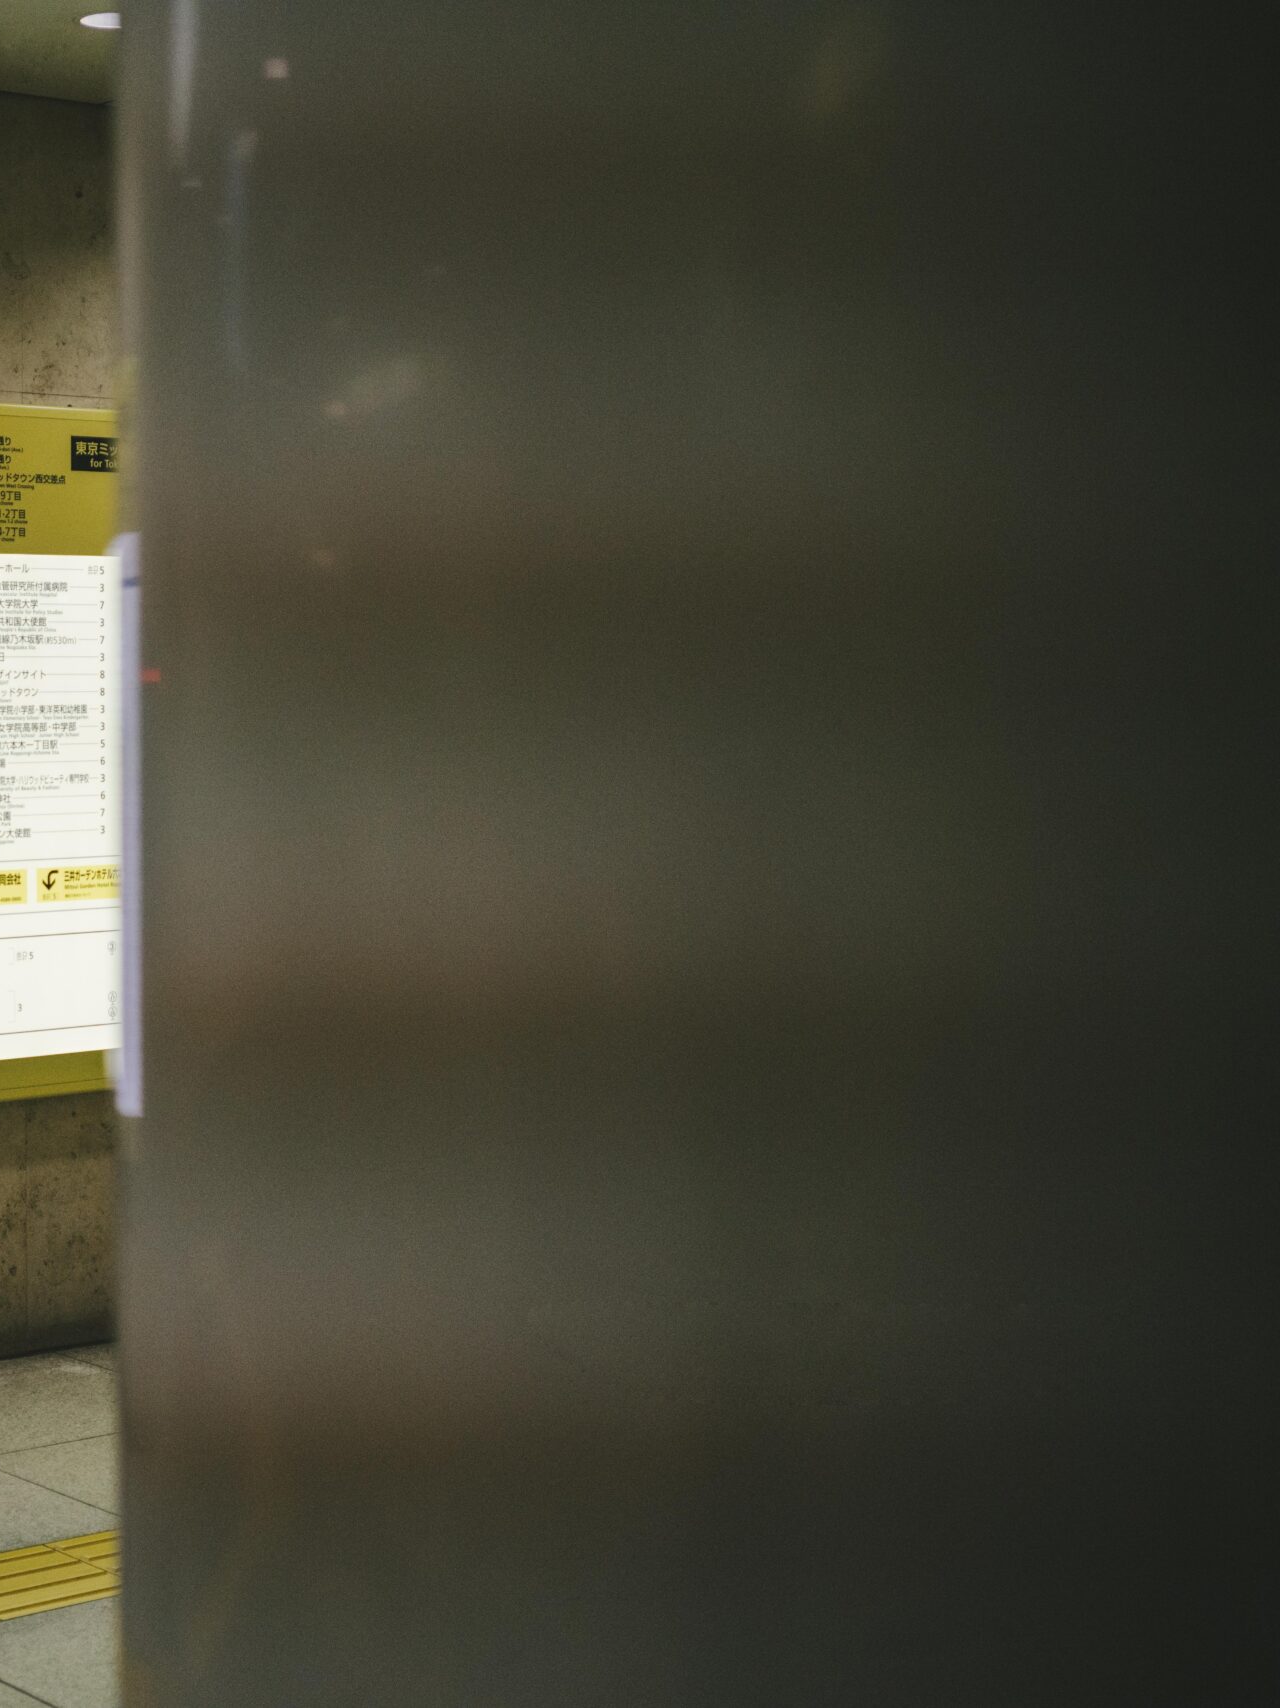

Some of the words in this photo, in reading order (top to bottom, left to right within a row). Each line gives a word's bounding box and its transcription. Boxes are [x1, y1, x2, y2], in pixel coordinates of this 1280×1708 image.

[90, 458, 103, 468] for
[99, 565, 105, 576] 5
[99, 583, 105, 593] 3
[99, 600, 105, 610] 7
[99, 618, 105, 628] 3
[99, 635, 105, 645] 7
[99, 653, 105, 662] 3
[99, 670, 106, 680] 8
[100, 688, 106, 697] 8
[100, 704, 106, 714] 3
[100, 721, 106, 731] 3
[100, 739, 106, 749] 5
[100, 757, 106, 766] 6
[100, 773, 106, 783] 3
[100, 791, 106, 801] 6
[100, 808, 106, 817] 7
[100, 824, 106, 835] 3
